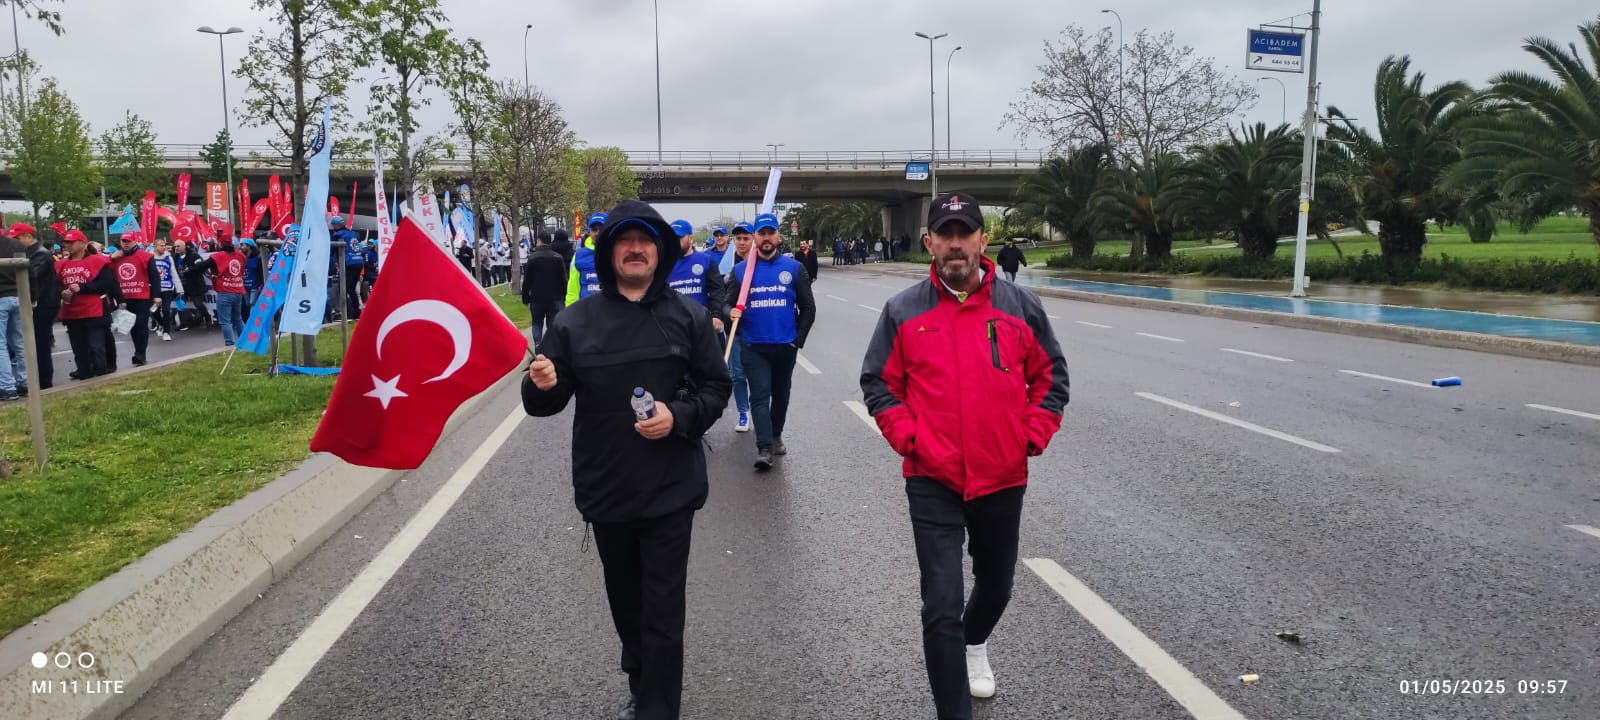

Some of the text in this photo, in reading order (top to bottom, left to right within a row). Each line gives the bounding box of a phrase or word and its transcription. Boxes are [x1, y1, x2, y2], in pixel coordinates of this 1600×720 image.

[1254, 38, 1298, 47] ACIBADEM
[212, 184, 222, 210] UTTS
[750, 298, 787, 309] SENDİKASI
